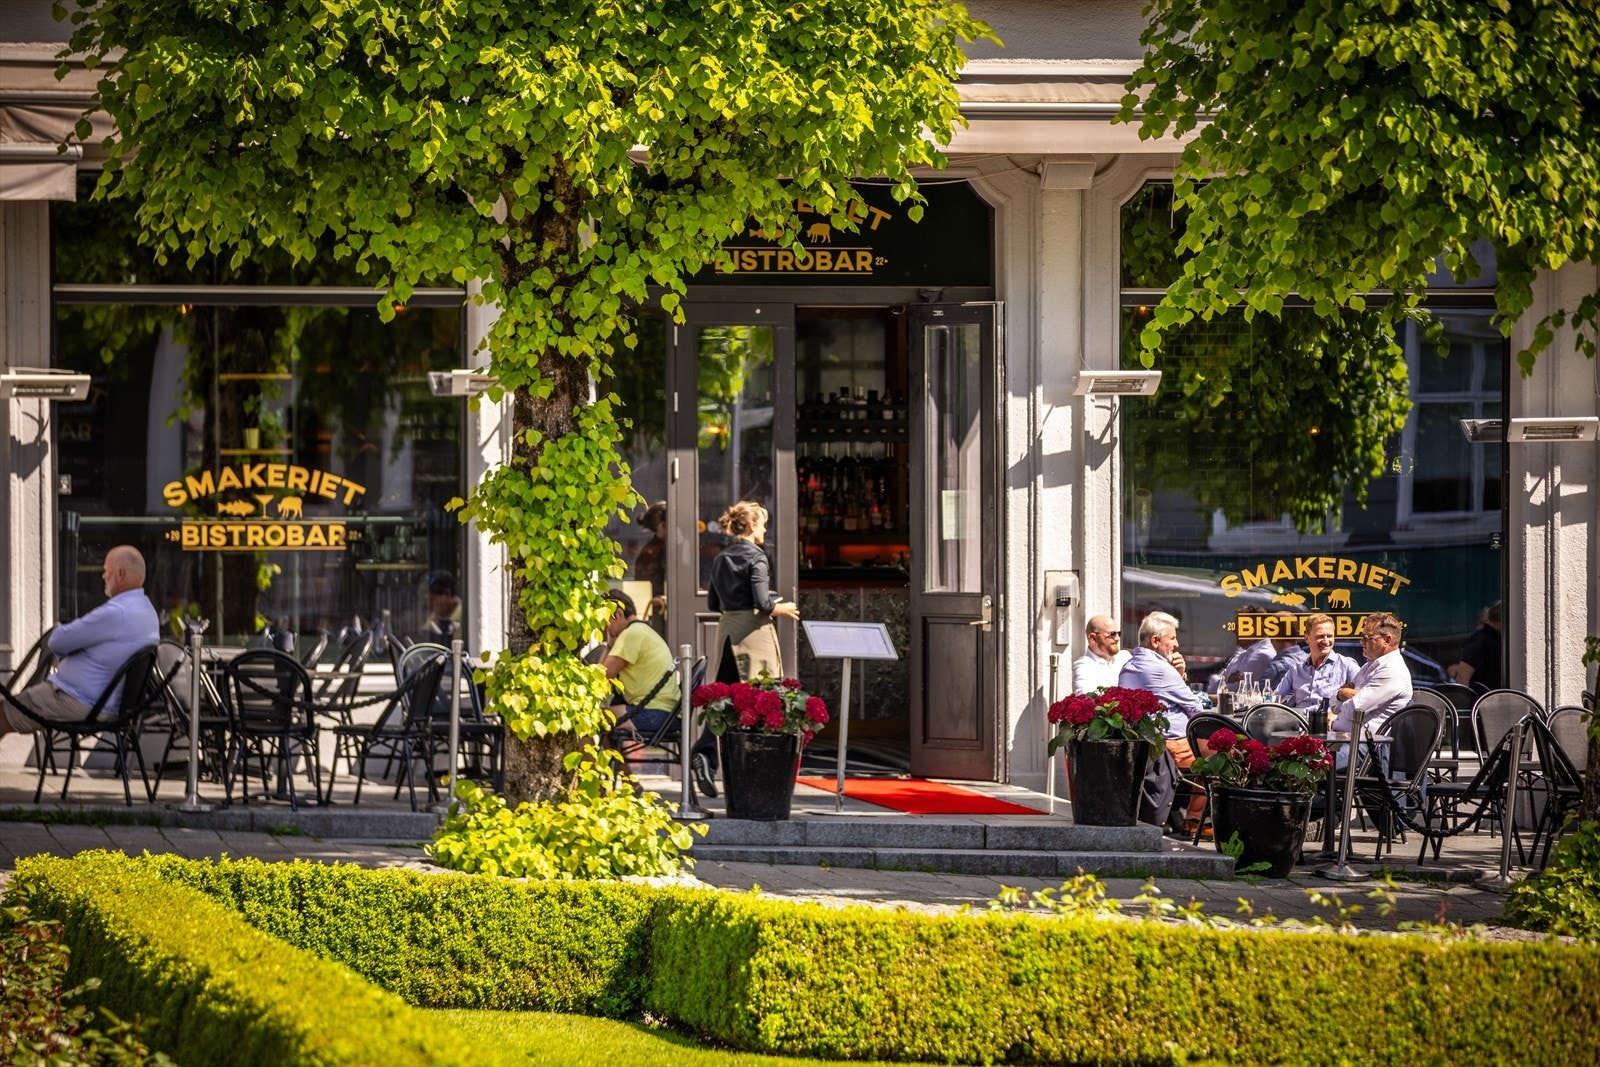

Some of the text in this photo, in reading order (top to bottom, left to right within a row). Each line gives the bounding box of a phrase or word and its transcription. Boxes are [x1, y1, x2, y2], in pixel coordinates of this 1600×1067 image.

[715, 251, 873, 271] ISTROBAR
[163, 463, 366, 507] SMAKERIET
[182, 525, 346, 546] BISTROBAR
[1220, 556, 1411, 598] SMAKERIET
